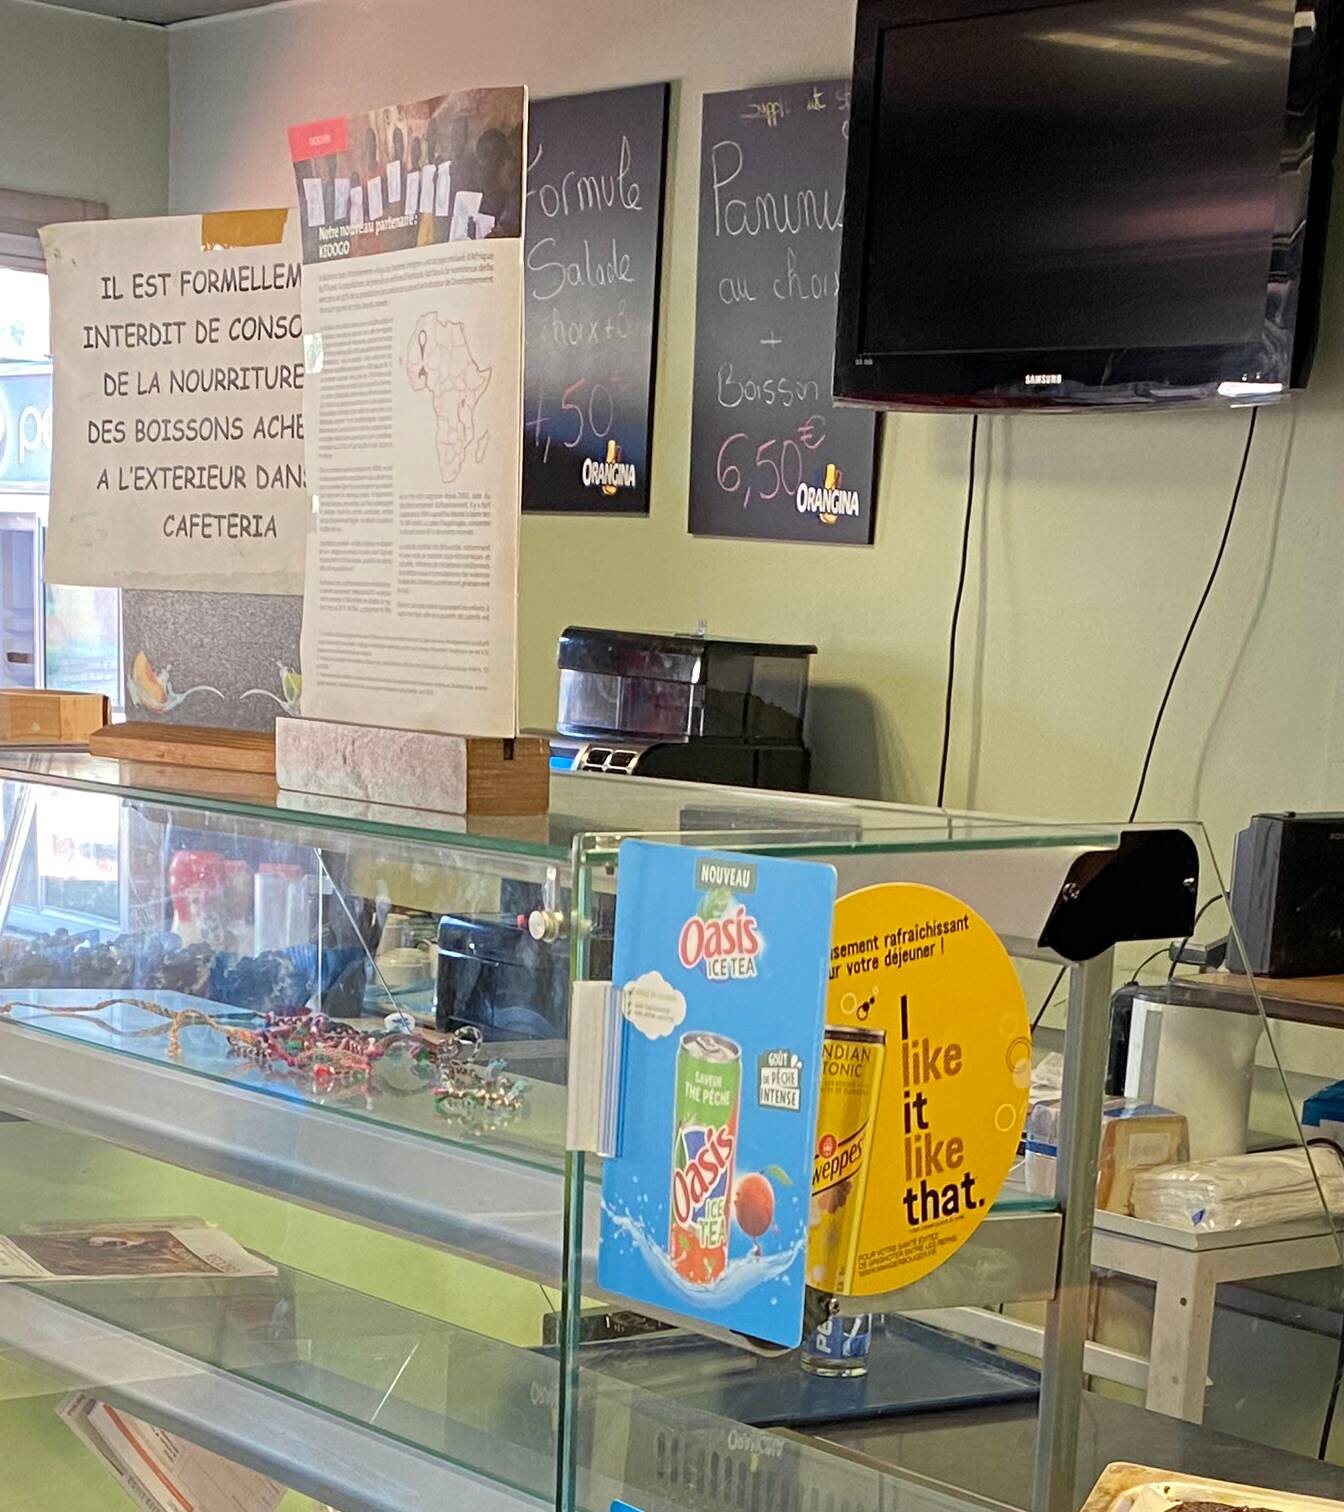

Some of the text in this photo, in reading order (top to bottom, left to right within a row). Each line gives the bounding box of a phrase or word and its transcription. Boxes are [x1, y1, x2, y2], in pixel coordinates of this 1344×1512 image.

[527, 238, 636, 299] Salade
[101, 276, 123, 300] IL
[132, 273, 171, 298] EST
[719, 277, 756, 304] au
[83, 320, 186, 350] INTERDIT
[195, 318, 220, 344] DE
[104, 363, 304, 397] DE LA NOURRITURE
[718, 362, 819, 408] Boisson
[1025, 373, 1062, 385] SAMSUNG
[87, 420, 125, 445] DES
[135, 417, 243, 444] BOISSONS
[97, 464, 307, 491] A L'EXTERIEUR DAN
[582, 458, 636, 487] ORANGINA
[796, 482, 859, 516] ORANGINA
[162, 513, 278, 540] CAFETERIA
[700, 864, 751, 888] NOUVEAU
[680, 906, 759, 968] Oasis
[708, 958, 756, 977] ICE TEA
[847, 956, 878, 976] votre
[902, 1037, 963, 1088] like
[761, 1086, 797, 1107] INTENSE
[903, 1090, 928, 1134] it
[904, 1133, 964, 1182] like
[673, 1124, 733, 1224] Oasis
[903, 1172, 985, 1226] that.
